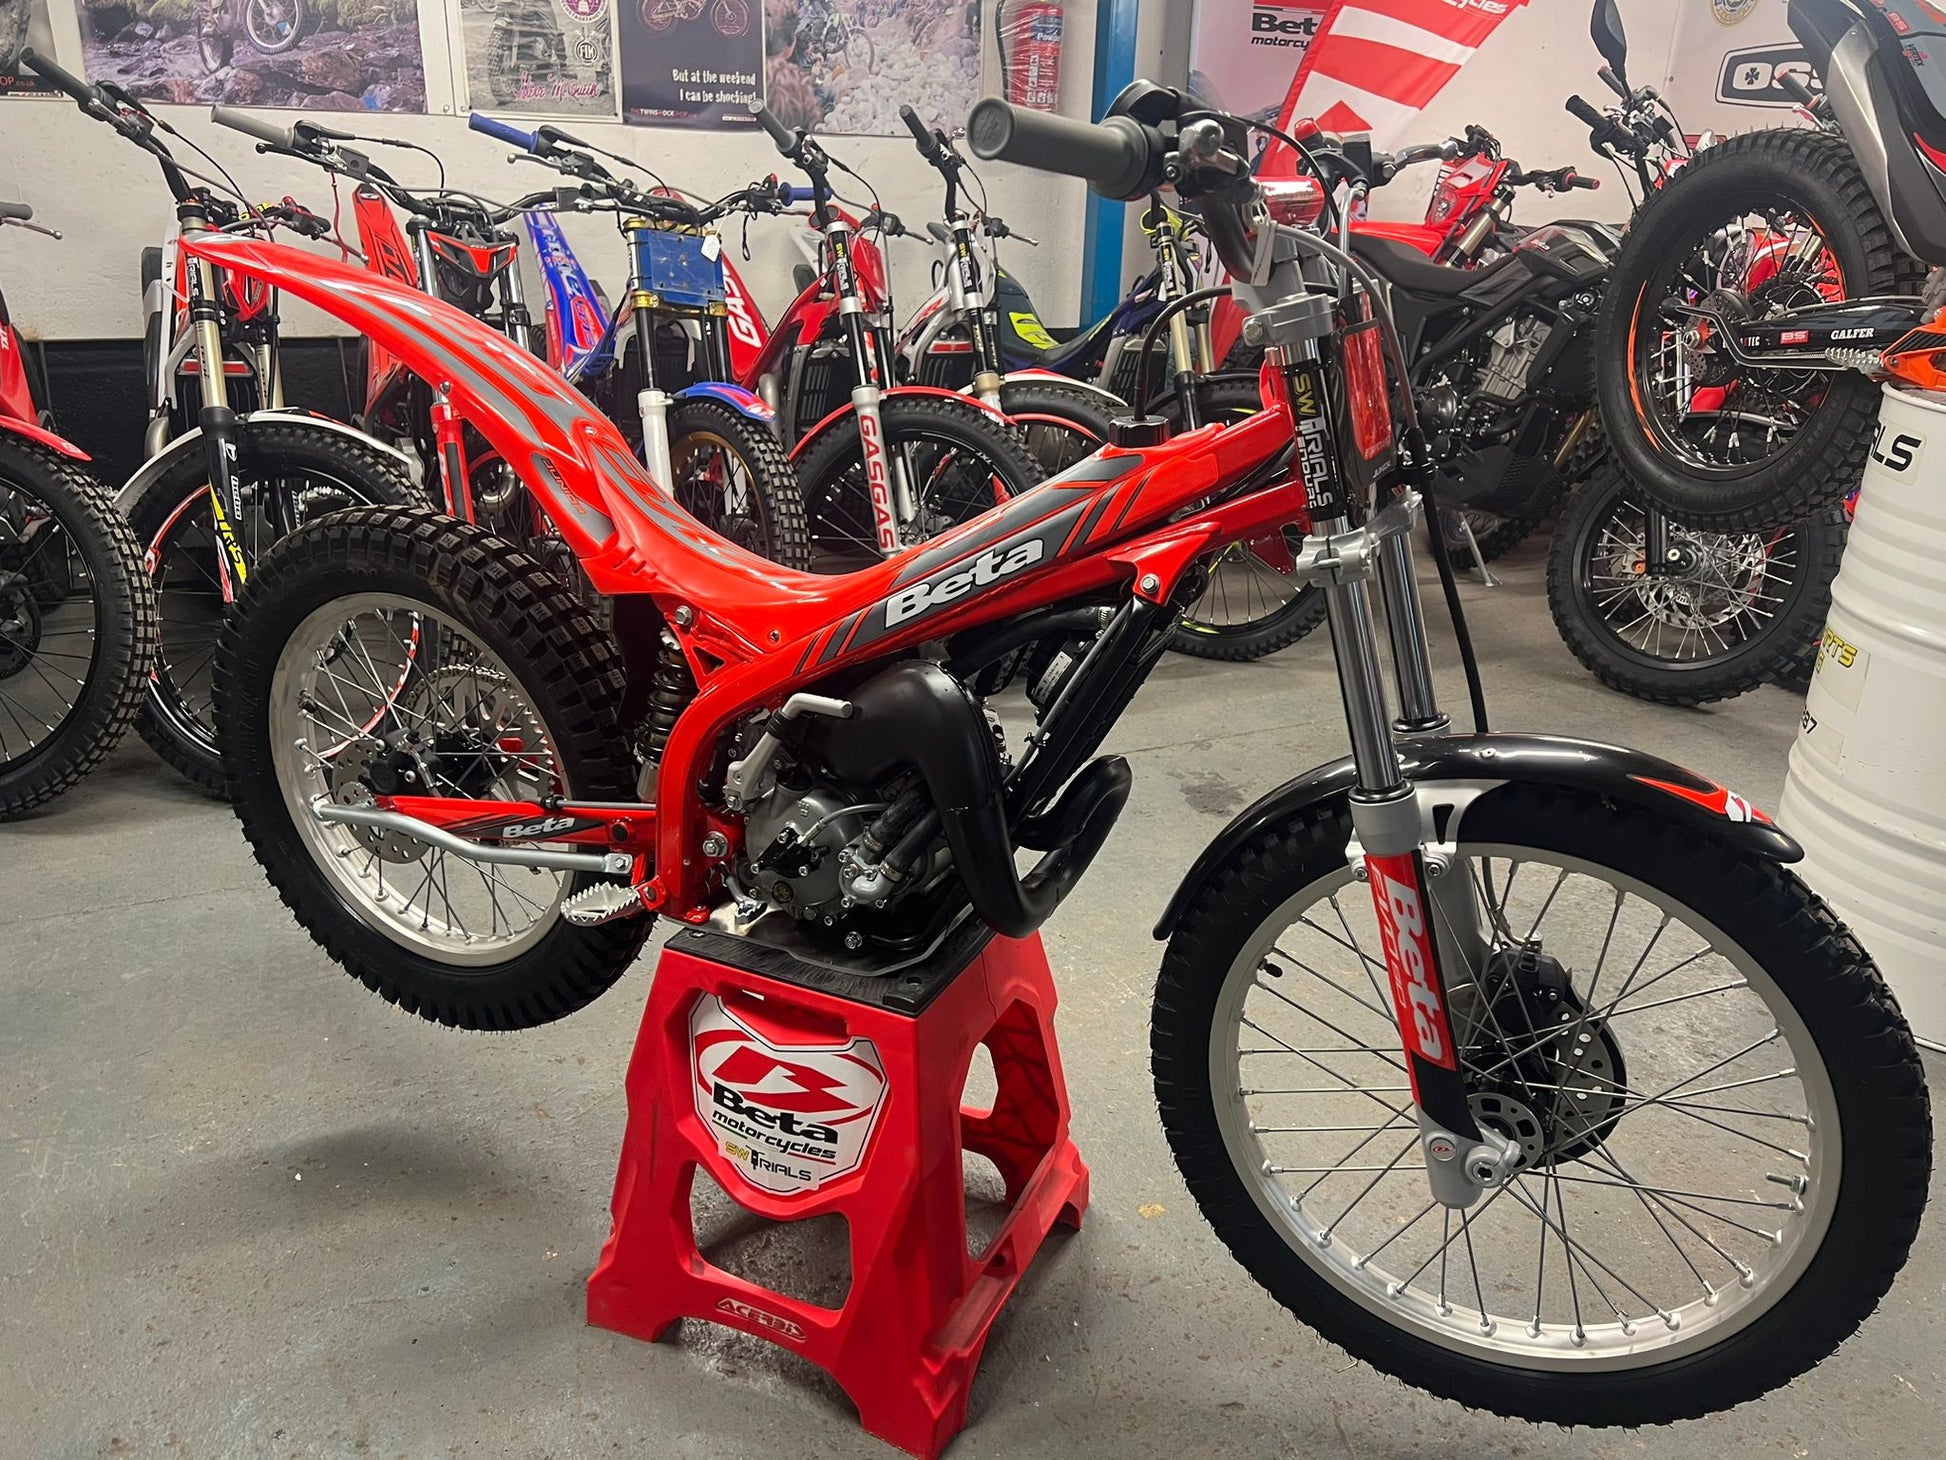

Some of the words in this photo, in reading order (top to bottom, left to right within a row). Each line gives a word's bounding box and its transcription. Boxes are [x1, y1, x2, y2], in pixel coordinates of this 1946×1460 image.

[1251, 36, 1311, 50] motorcy
[1252, 13, 1319, 36] Bet
[672, 69, 689, 82] But
[691, 70, 700, 83] at
[703, 70, 717, 84] the
[719, 71, 756, 86] weekend
[680, 88, 684, 102] I
[685, 91, 700, 103] can
[702, 90, 714, 103] be
[723, 262, 762, 348] GAS
[1781, 331, 1808, 340] BS
[1830, 328, 1875, 340] GALFER
[1292, 372, 1317, 417] SW
[1295, 402, 1334, 508] TRIALS
[1871, 426, 1922, 472] LS
[541, 456, 587, 516] JUNIOR
[859, 414, 895, 549] GASGAS
[885, 538, 1045, 630] Beta
[502, 816, 576, 839] Beta
[1384, 875, 1443, 1061] Beta
[712, 1109, 837, 1160] motorcycles
[713, 1081, 839, 1145] Beta
[725, 1141, 750, 1162] SW
[745, 1145, 812, 1183] TRIALS
